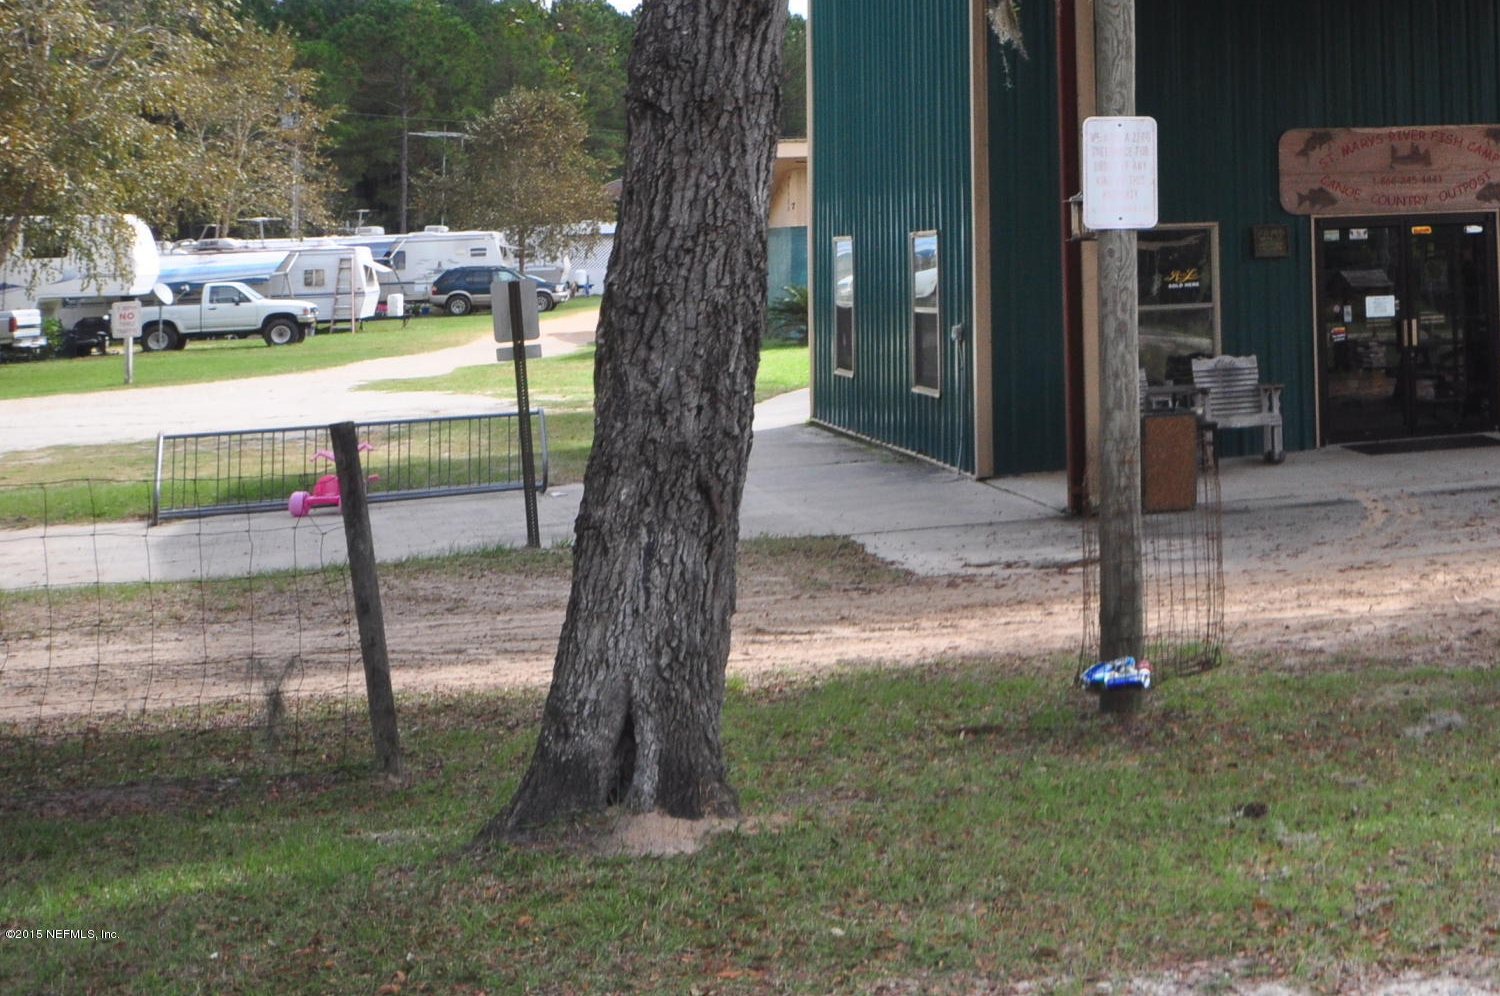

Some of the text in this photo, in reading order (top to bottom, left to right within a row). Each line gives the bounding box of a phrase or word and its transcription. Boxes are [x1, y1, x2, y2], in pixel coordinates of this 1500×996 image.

[1341, 134, 1384, 156] MARYS
[1388, 129, 1426, 142] RIVER
[1430, 131, 1464, 146] FISH
[1466, 141, 1500, 162] CAMP
[1320, 174, 1362, 199] CANOE
[1439, 170, 1492, 202] OUTPOST
[1371, 193, 1429, 207] COUNTRY
[119, 312, 135, 320] NO
